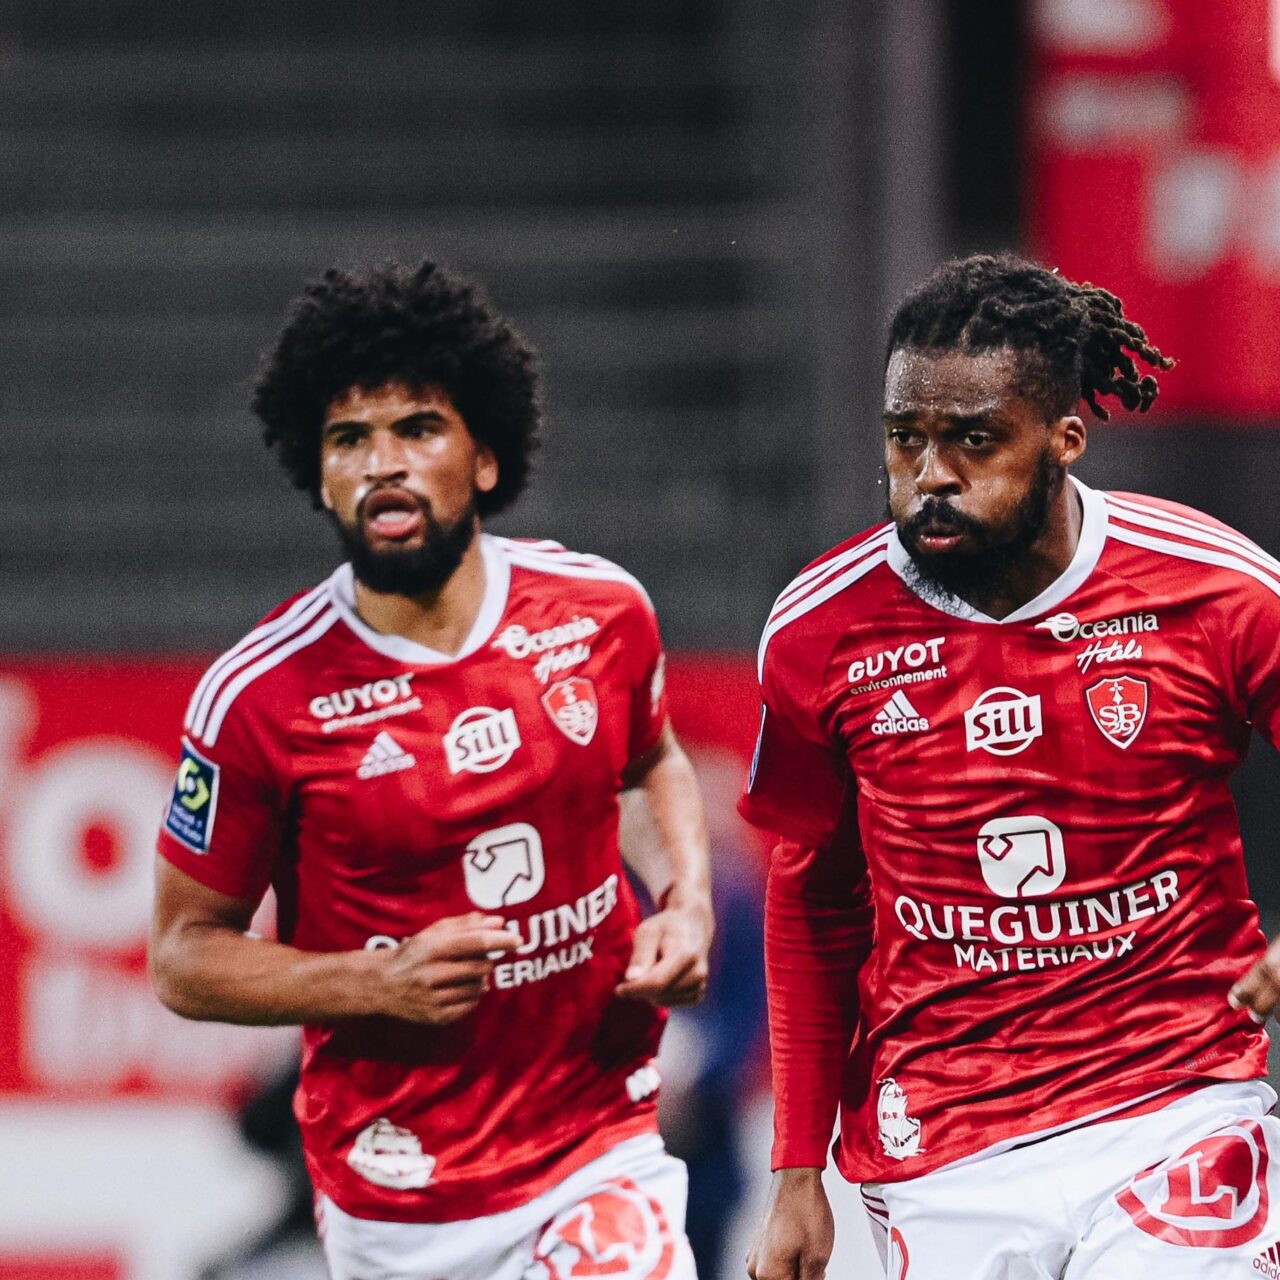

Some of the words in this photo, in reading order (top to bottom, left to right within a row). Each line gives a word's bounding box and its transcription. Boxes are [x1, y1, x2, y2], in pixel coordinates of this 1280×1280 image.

[1035, 612, 1159, 642] Oceania
[847, 636, 946, 683] GUYOT
[1076, 639, 1143, 674] Hotels
[309, 672, 415, 720] GUYOT
[850, 666, 948, 696] environnement
[871, 717, 930, 735] adidas
[894, 870, 1180, 945] QUEGUINER
[492, 936, 595, 990] ERIAUX
[953, 931, 1137, 973] MATERIAUX
